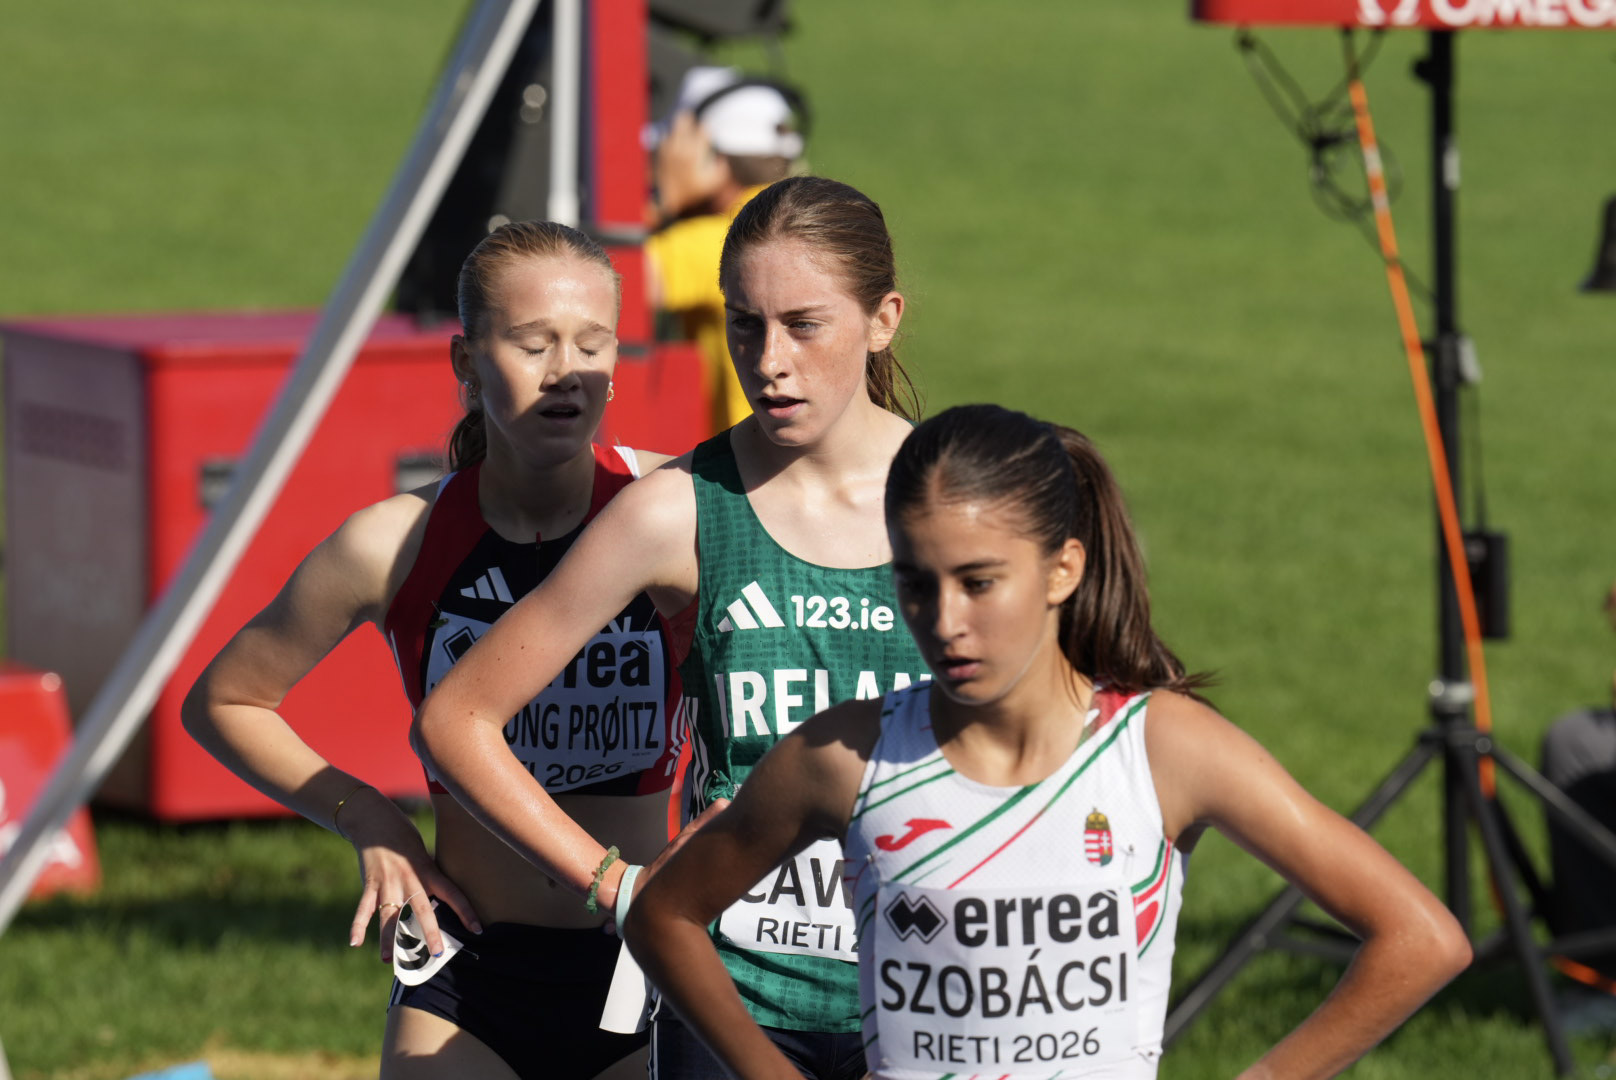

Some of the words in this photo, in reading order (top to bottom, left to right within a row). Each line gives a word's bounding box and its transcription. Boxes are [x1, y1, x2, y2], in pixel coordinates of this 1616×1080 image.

[1429, 0, 1616, 27] OMEG
[791, 595, 894, 631] 123.ie
[503, 703, 560, 750] UNG
[568, 696, 659, 758] PRØITZ
[545, 761, 625, 788] 2026
[756, 917, 842, 951] RIETI
[880, 949, 1128, 1018] SZOBÁCSI
[913, 1030, 1000, 1064] RIETI
[1013, 1027, 1100, 1063] 2026
